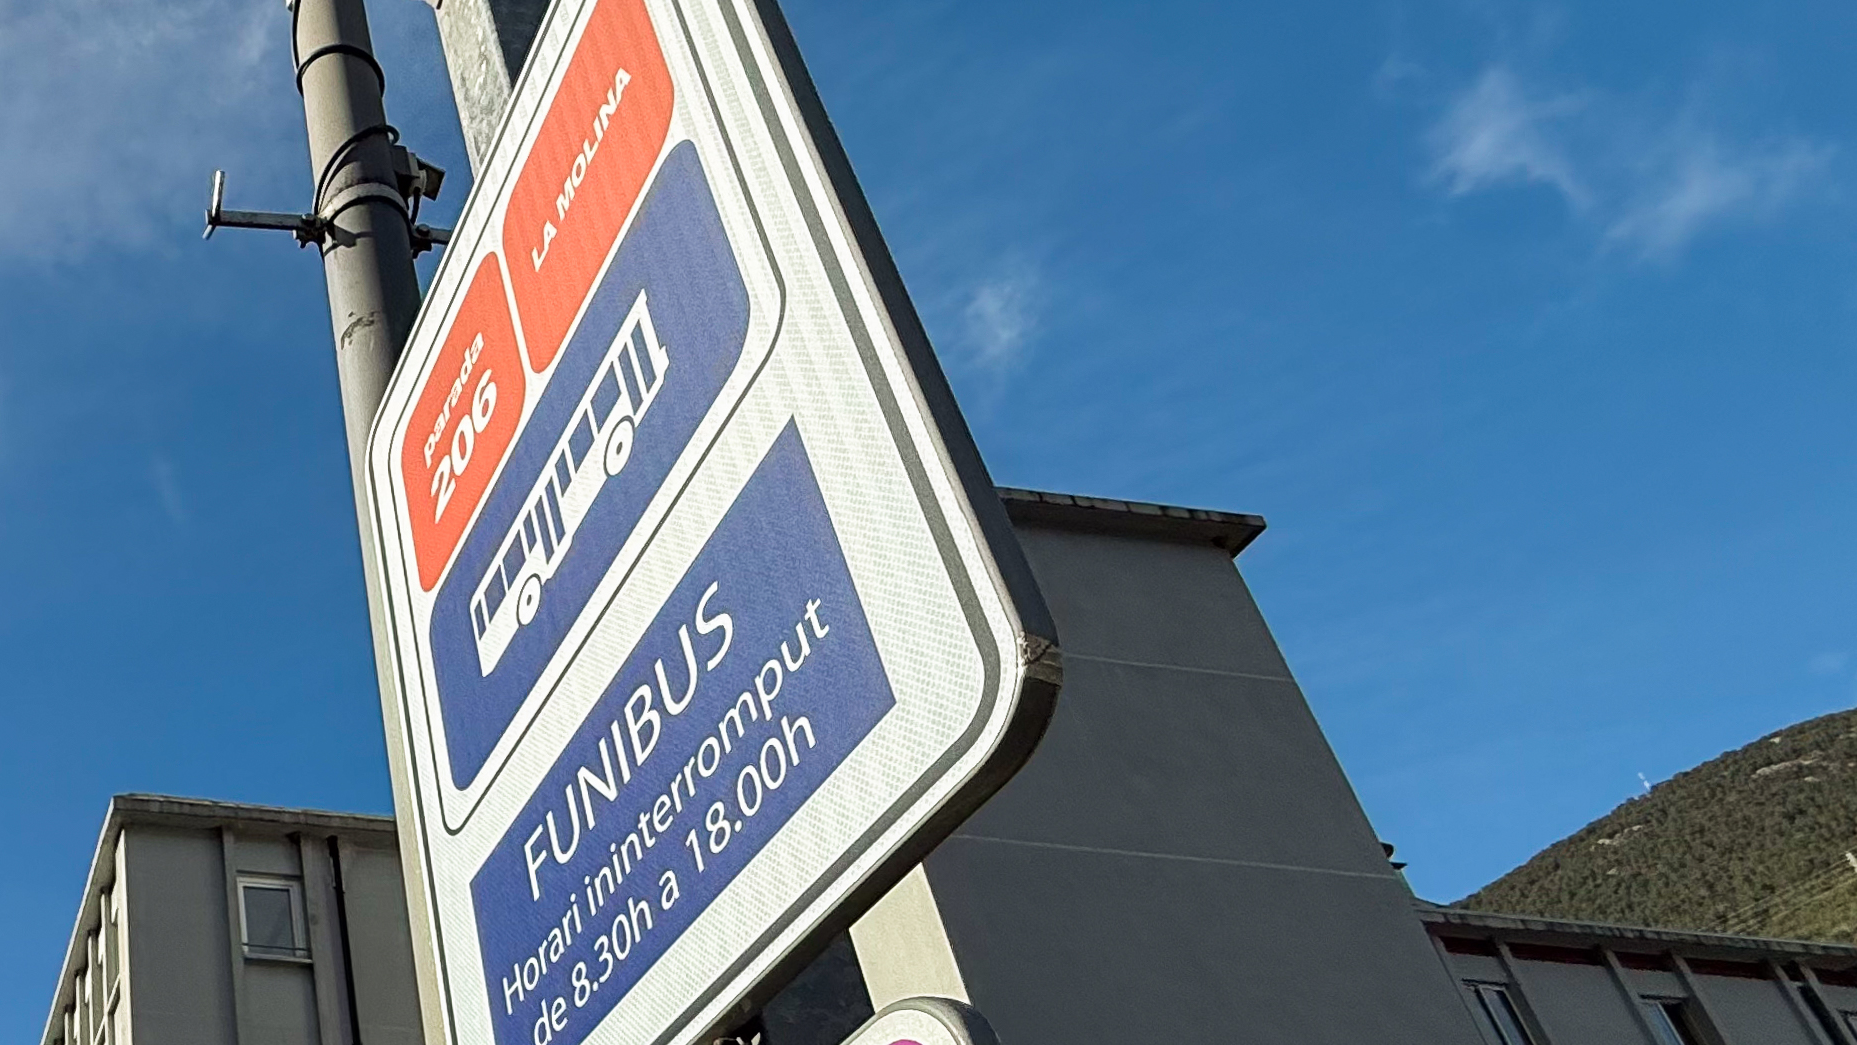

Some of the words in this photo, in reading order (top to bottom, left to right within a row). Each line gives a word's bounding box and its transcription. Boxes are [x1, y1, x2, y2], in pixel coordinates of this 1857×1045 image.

[531, 220, 558, 272] LA
[555, 67, 632, 223] MOLINA
[423, 331, 486, 467] parada
[430, 368, 499, 524] 206
[502, 892, 584, 1015] Horari
[583, 597, 832, 918] ininterromput
[523, 581, 735, 902] FUNIBUS
[573, 899, 655, 1009] 8.30h
[659, 869, 682, 910] a
[683, 713, 818, 874] 18.00h
